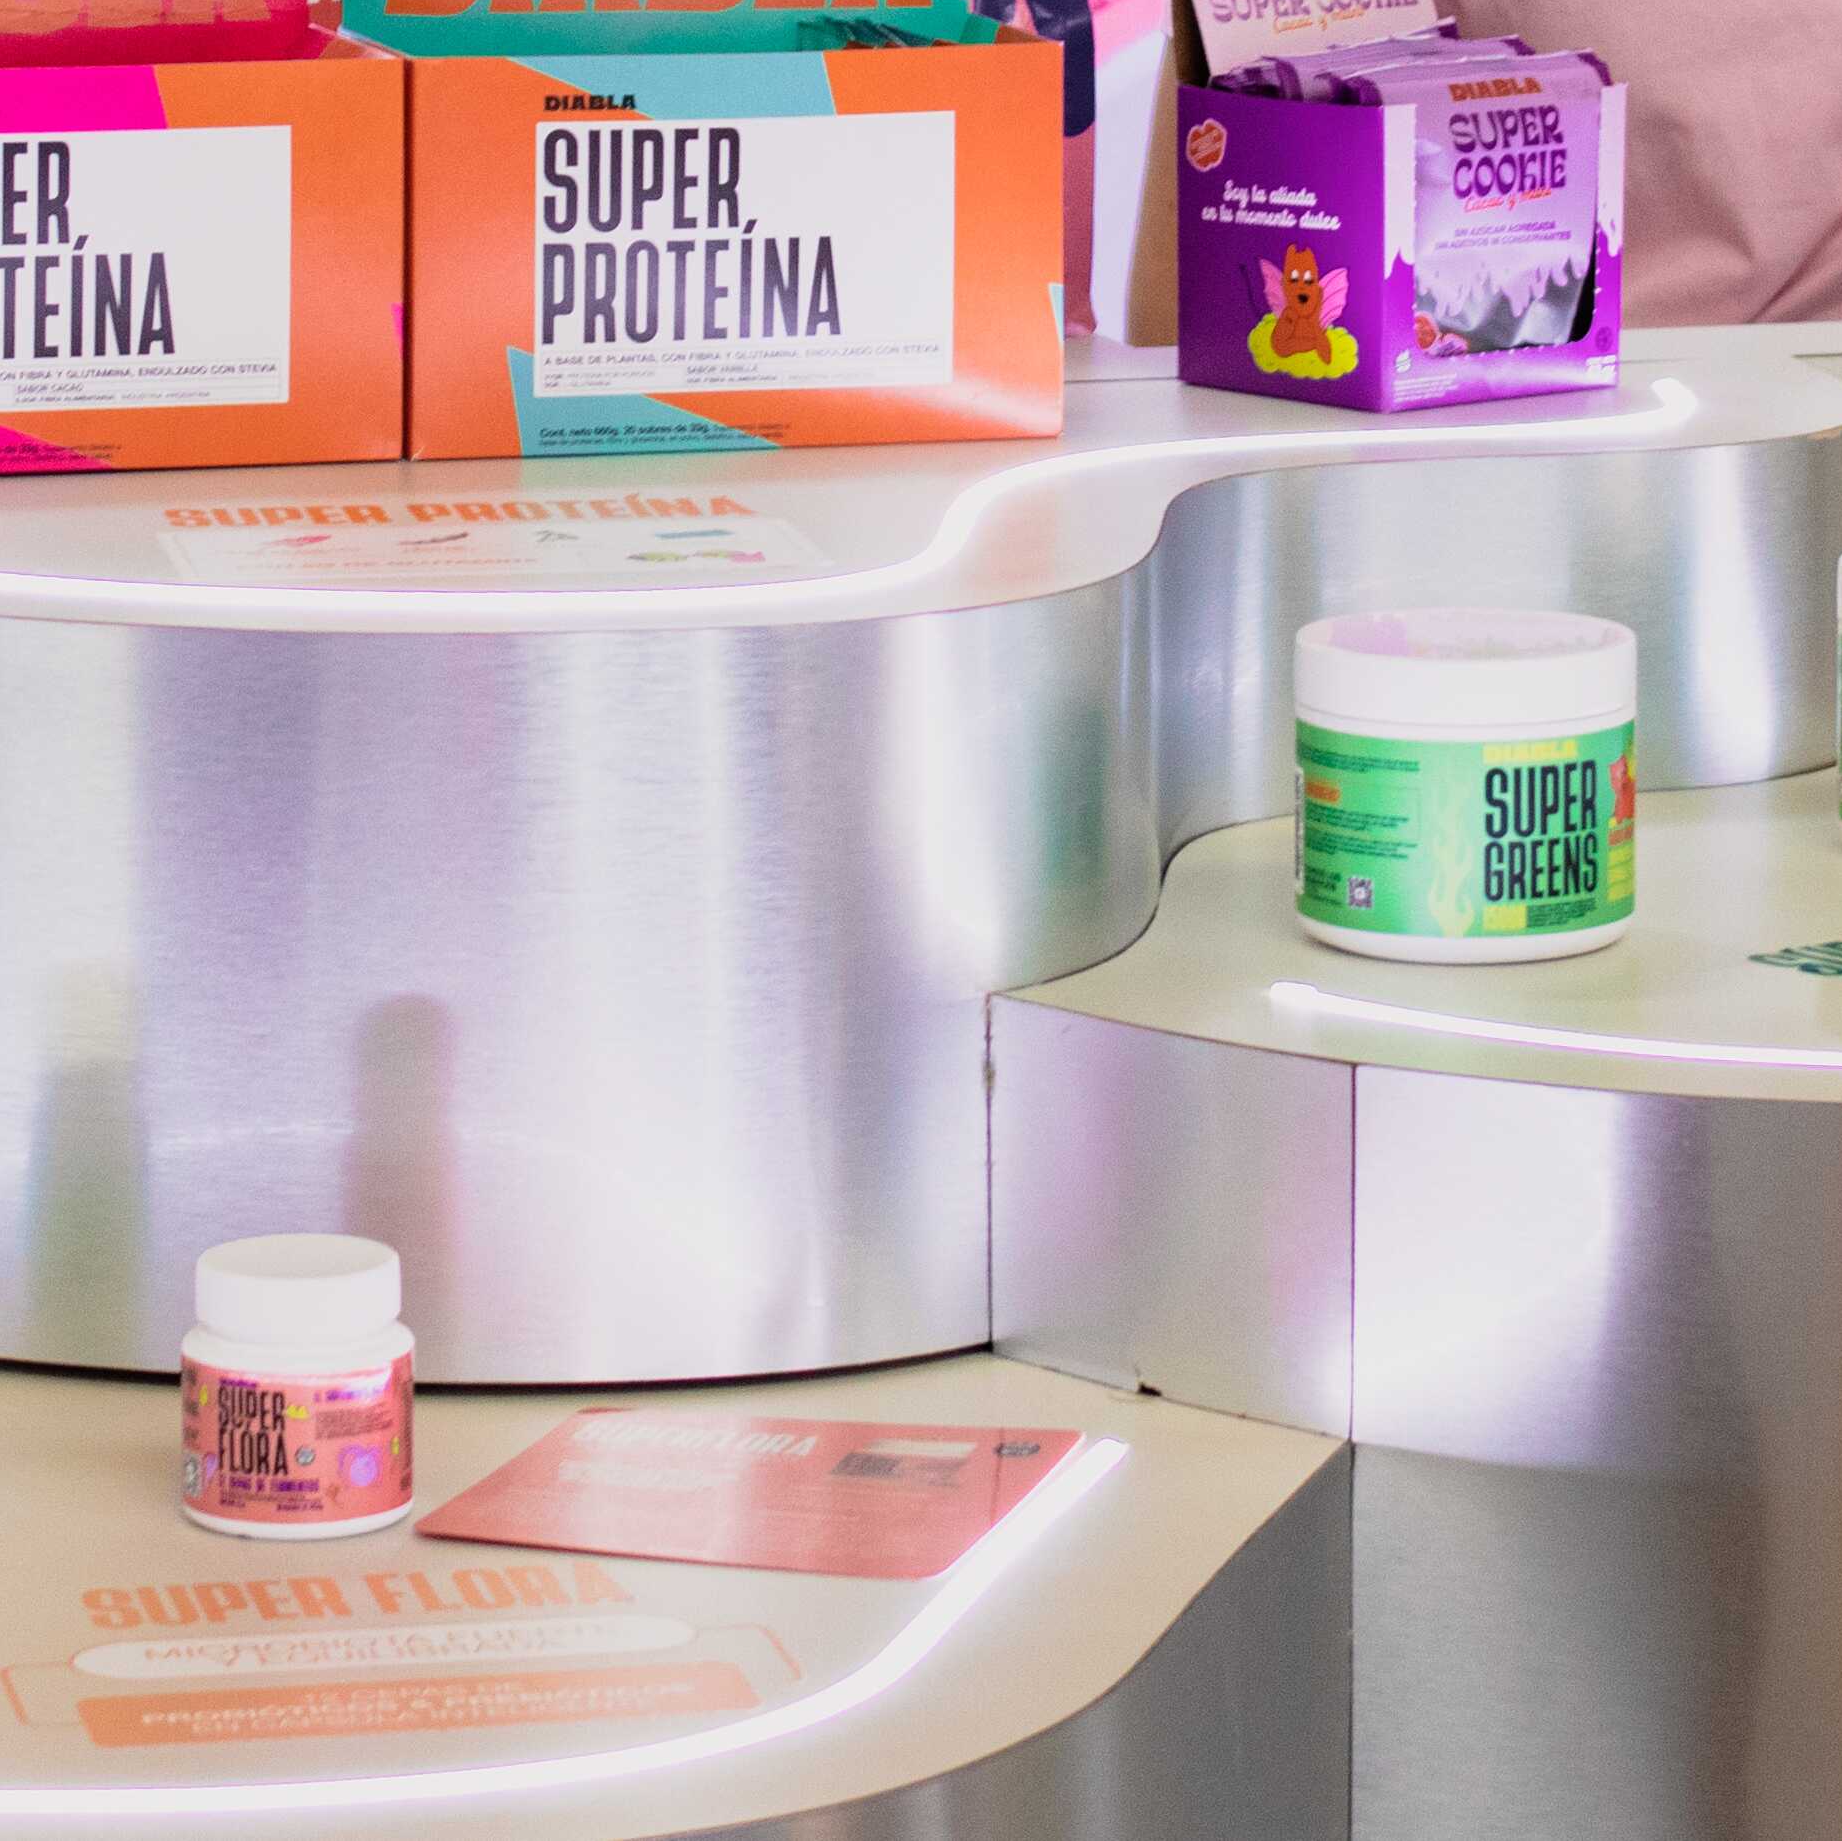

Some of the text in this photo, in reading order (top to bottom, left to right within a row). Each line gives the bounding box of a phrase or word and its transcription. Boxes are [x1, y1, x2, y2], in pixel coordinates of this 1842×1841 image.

[544, 93, 637, 112] DIABLA
[1449, 77, 1542, 102] DIABLA
[1448, 104, 1564, 154] SUPER
[544, 127, 742, 234] SUPER
[1453, 148, 1567, 200] COOKIE
[1298, 209, 1342, 231] dulce
[542, 218, 842, 346] PROTEÍNA
[164, 493, 759, 528] SUPER PROTEÍNA
[1484, 759, 1597, 839] SUPER
[1484, 831, 1599, 902] GREENS
[218, 1384, 286, 1432] SUPER
[218, 1429, 288, 1475] FLORA
[82, 1562, 636, 1629] SUPER FLORA
